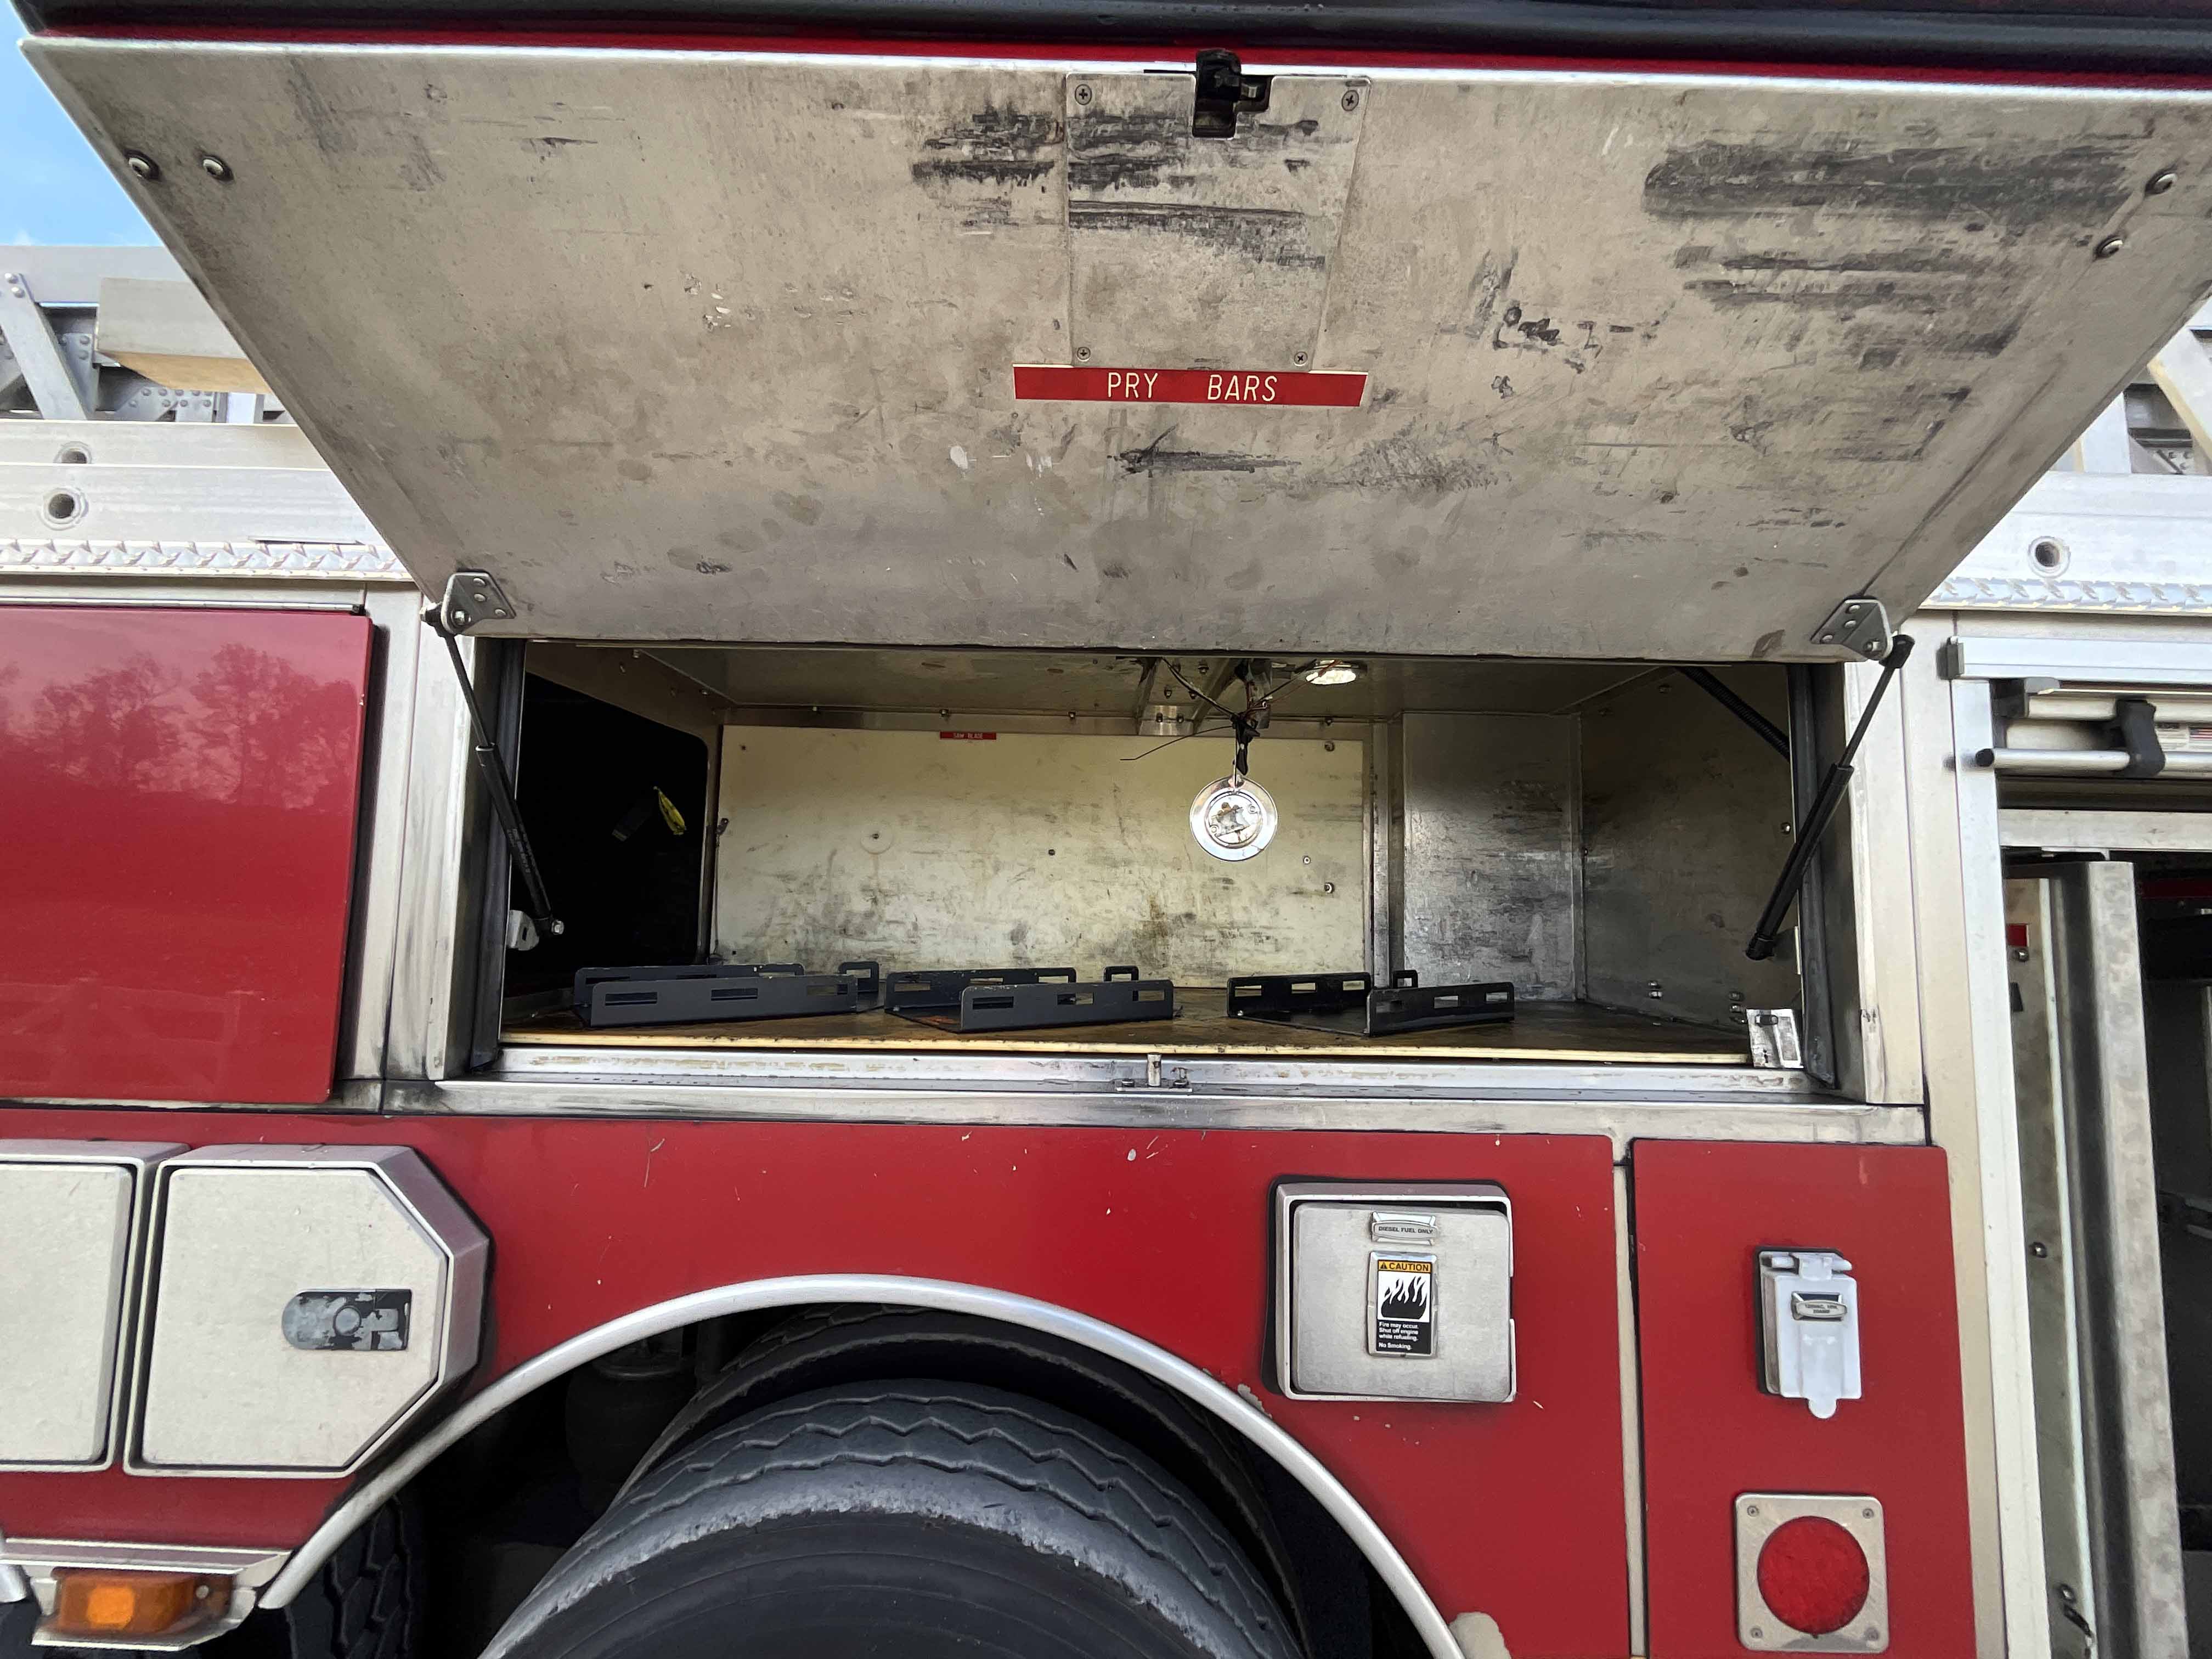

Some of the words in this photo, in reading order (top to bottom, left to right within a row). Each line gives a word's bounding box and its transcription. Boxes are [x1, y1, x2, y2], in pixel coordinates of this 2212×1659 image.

[1108, 372, 1158, 398] PRY
[1207, 374, 1277, 402] BARS
[1389, 1262, 1429, 1272] CAUTION
